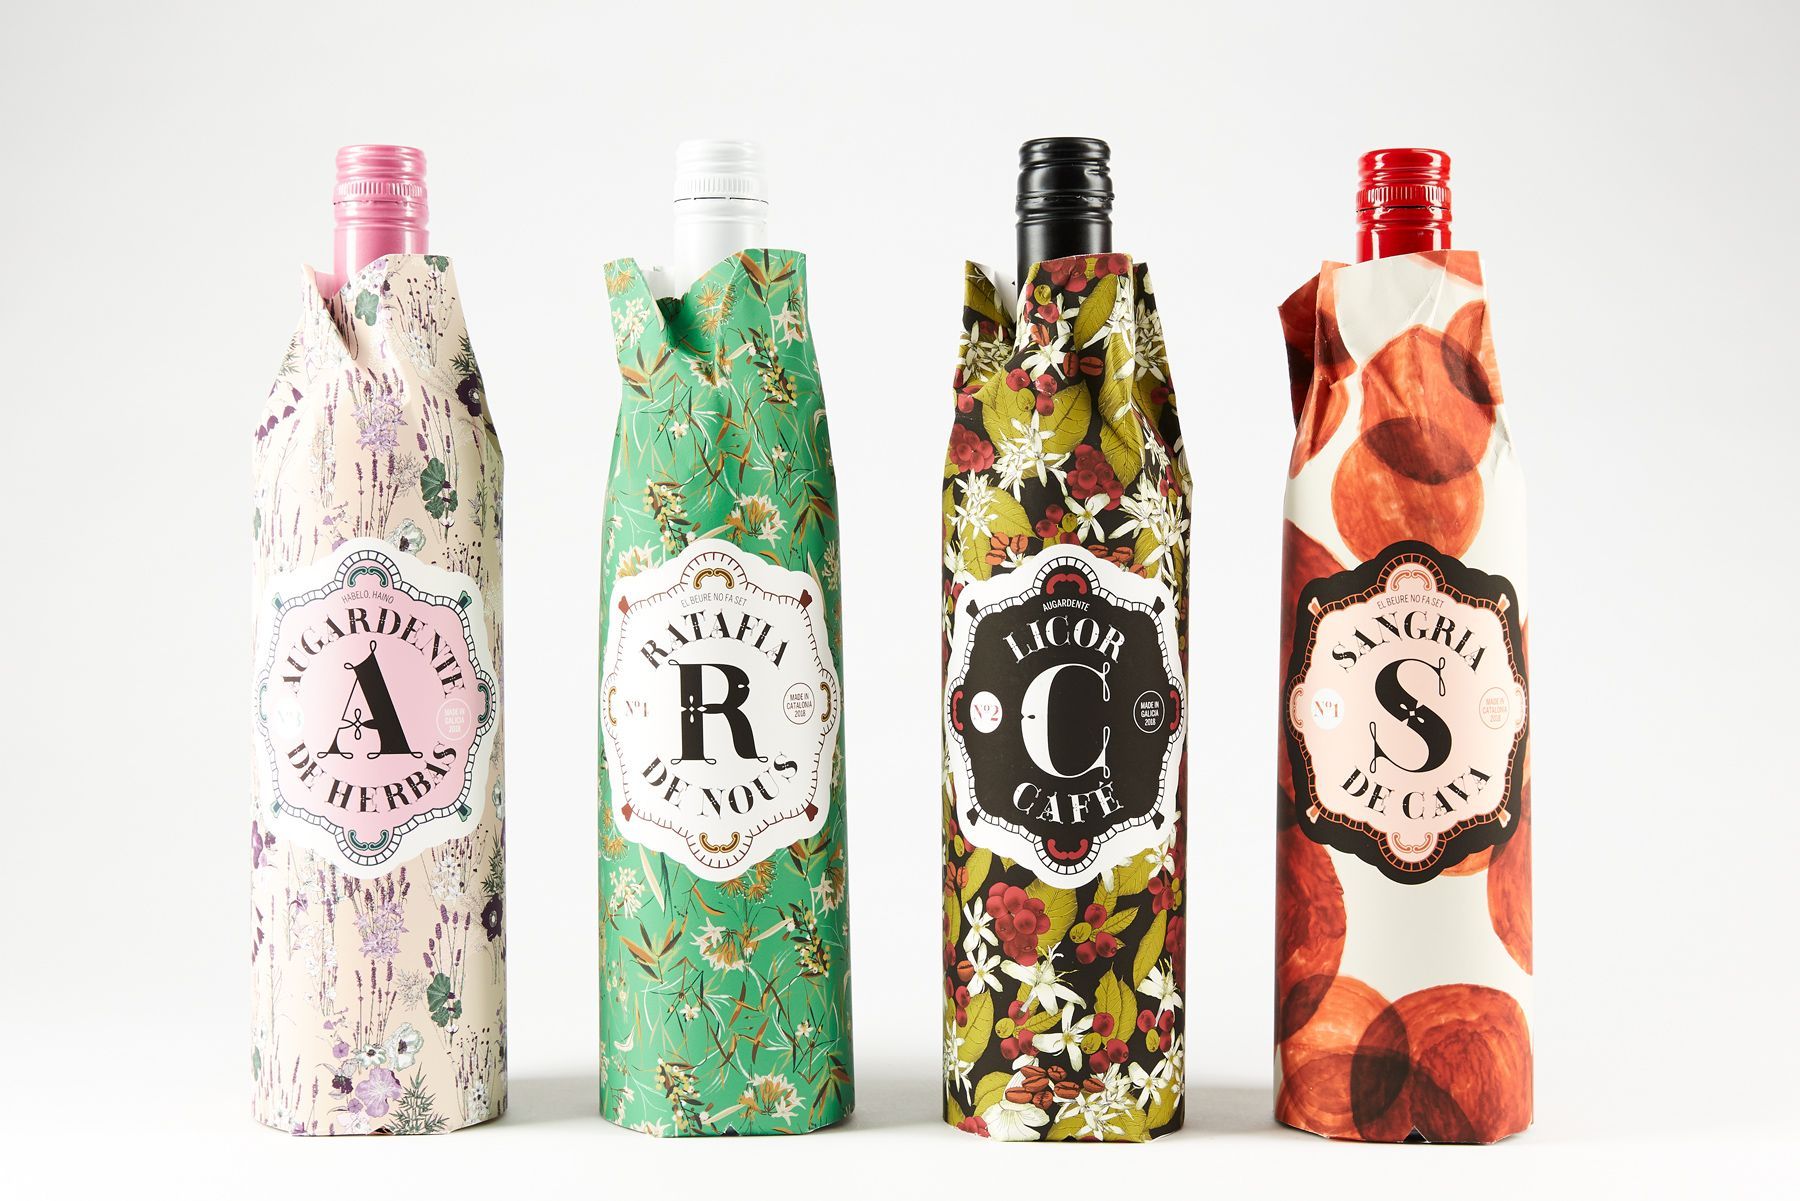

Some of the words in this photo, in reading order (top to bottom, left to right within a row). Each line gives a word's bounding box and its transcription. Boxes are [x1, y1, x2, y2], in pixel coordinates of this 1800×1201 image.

[680, 599, 690, 608] EL
[690, 592, 711, 605] BEURE
[713, 592, 724, 602] NO
[725, 593, 733, 602] FA
[734, 595, 747, 606] SET
[1042, 598, 1091, 612] AUGARDENTE
[1376, 600, 1387, 610] EL
[1386, 594, 1409, 607] BEURE
[1410, 593, 1421, 603] NO
[1421, 595, 1431, 604] FA
[1431, 597, 1445, 608] SET
[281, 606, 465, 698] AUGARDENTE
[640, 609, 790, 670] RATAFIA
[1002, 614, 1127, 664] LICOR
[1331, 610, 1489, 674] SANGRIA
[317, 640, 423, 760] A
[668, 659, 768, 765] R
[786, 700, 813, 710] CATALONIA
[790, 693, 804, 701] MADE
[804, 692, 810, 700] IN
[794, 709, 806, 718] 2018
[1021, 661, 1111, 779] C
[1140, 701, 1154, 710] MADE
[1154, 700, 1160, 709] IN
[1140, 709, 1160, 718] GALICIA
[1144, 718, 1156, 727] 2018
[1369, 657, 1453, 774] S
[287, 741, 327, 792] DE
[323, 740, 457, 814] HERBAS
[641, 756, 690, 809] DE
[697, 751, 798, 818] NOUS
[1339, 765, 1395, 816] DE
[1401, 764, 1493, 820] CAVA
